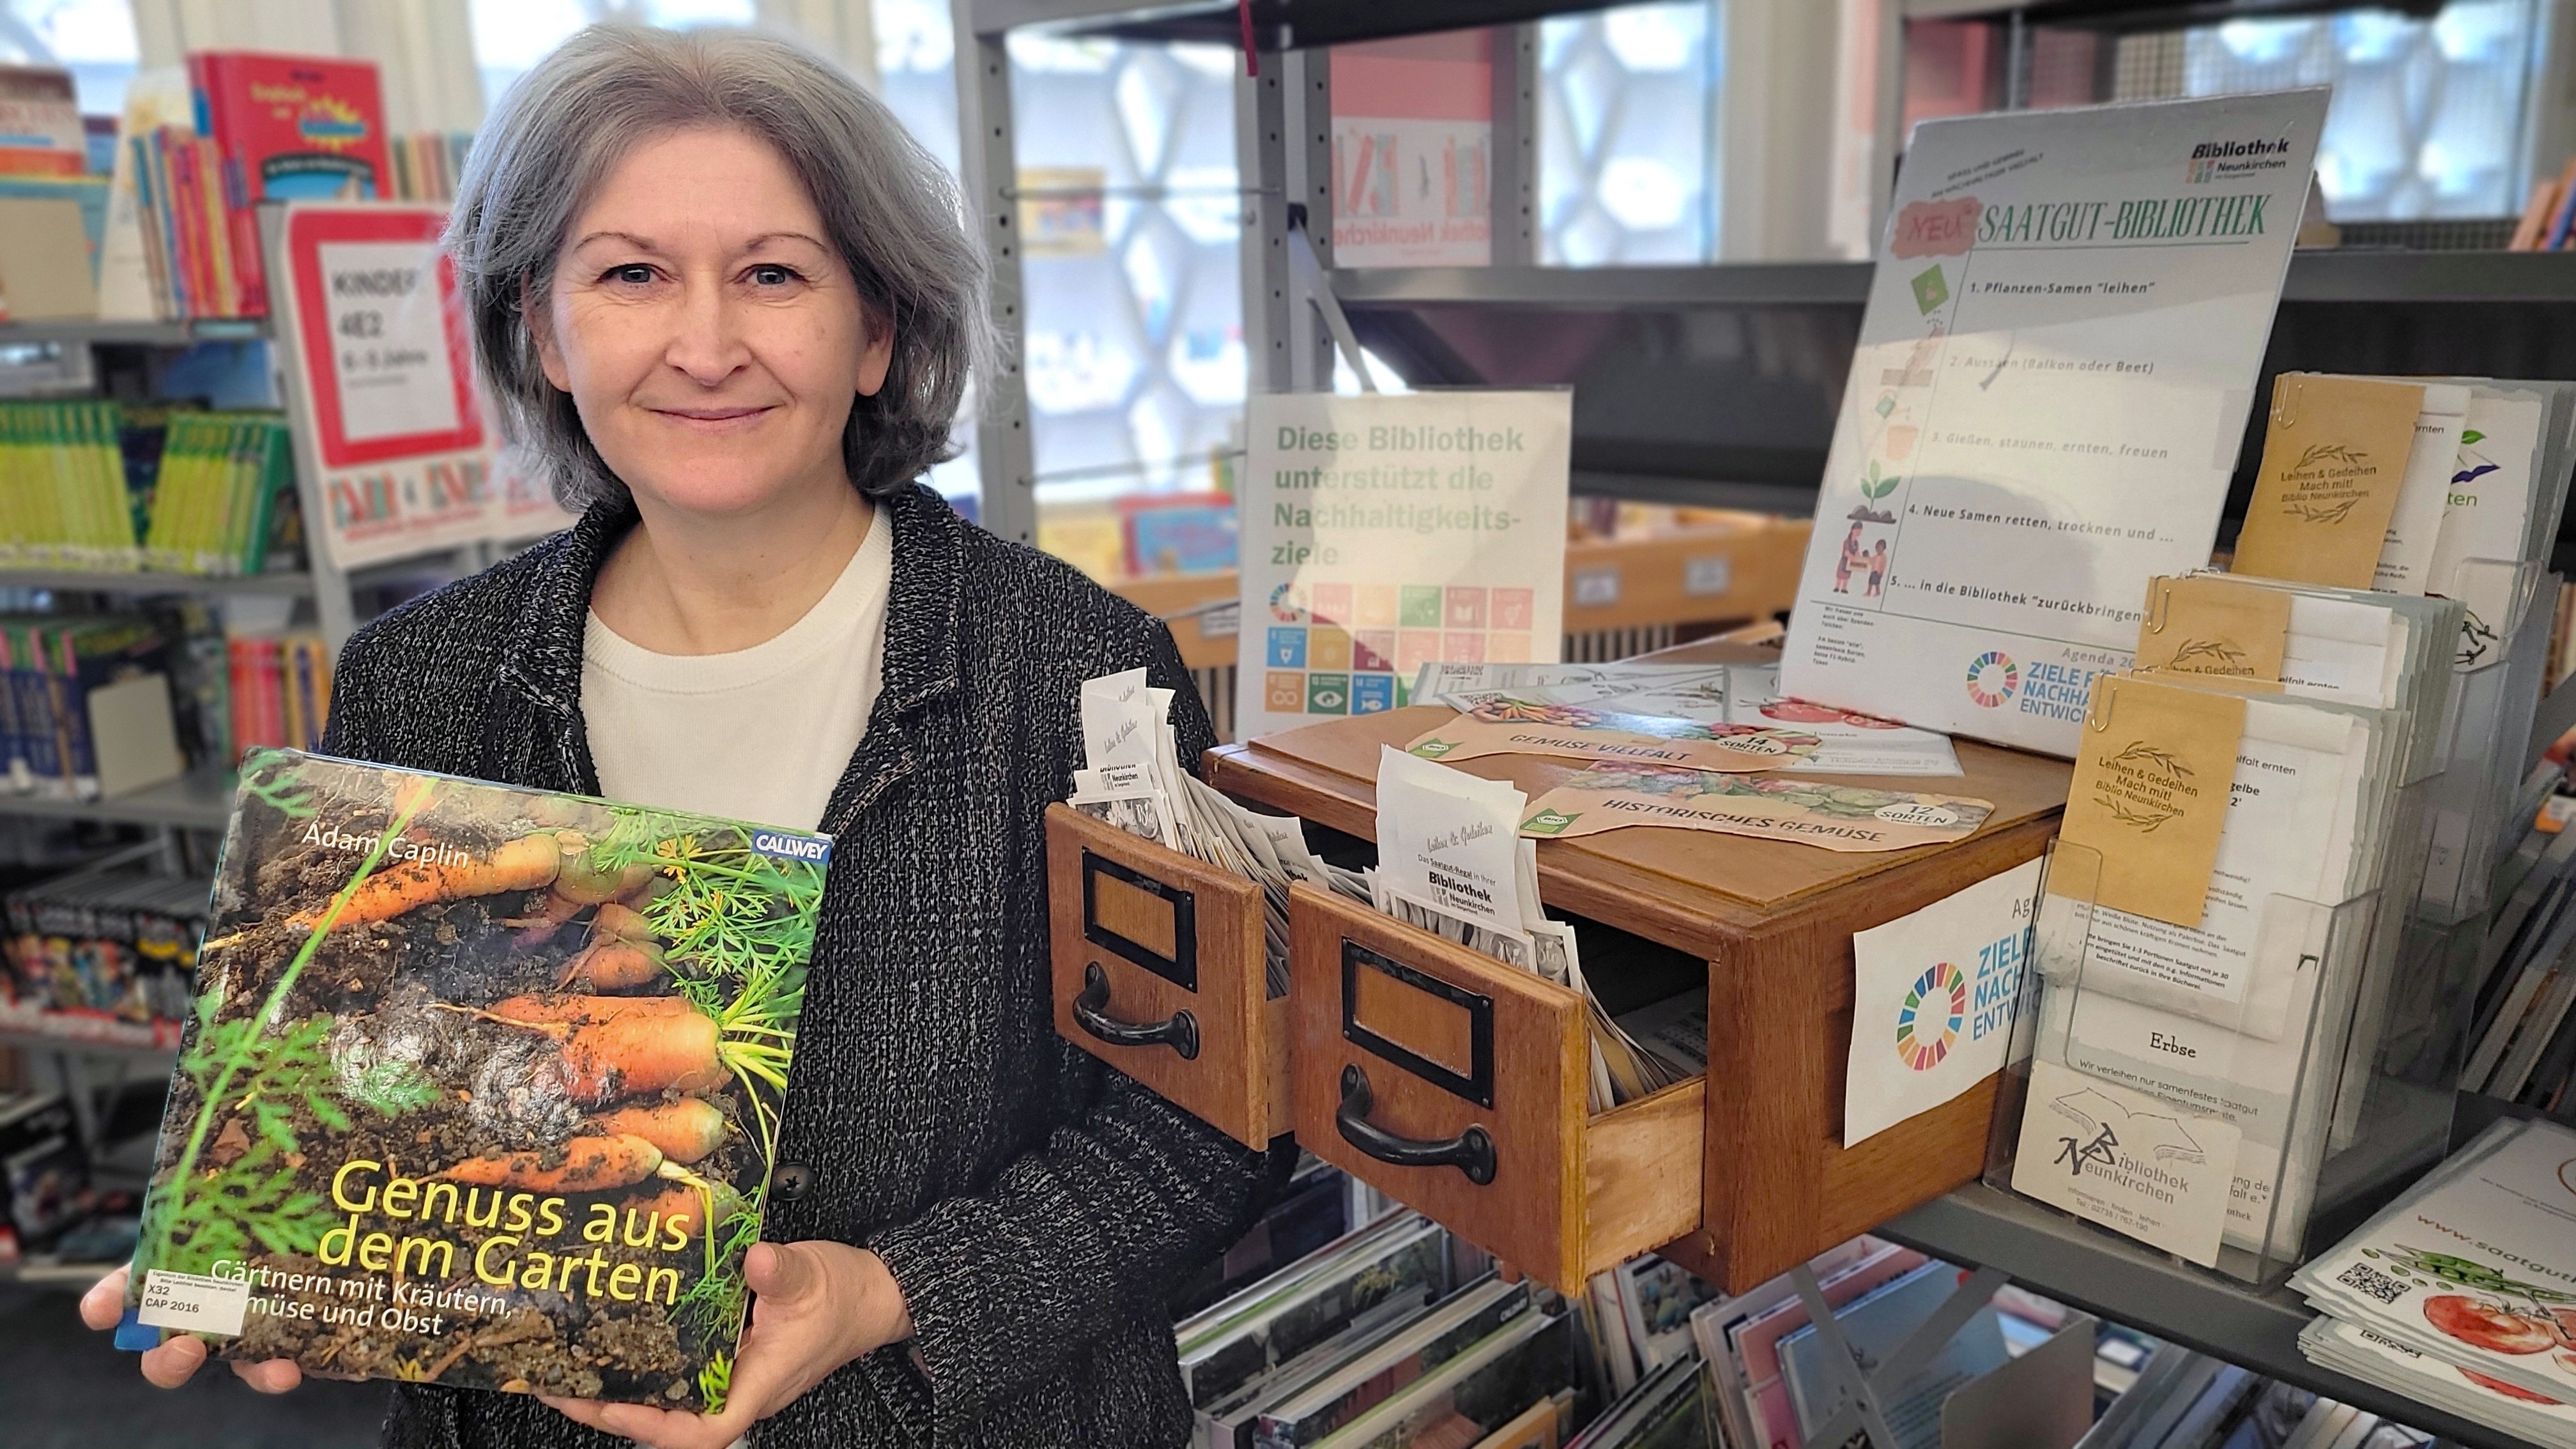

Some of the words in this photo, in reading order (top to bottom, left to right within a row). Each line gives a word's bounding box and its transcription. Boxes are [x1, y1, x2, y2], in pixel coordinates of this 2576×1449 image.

[2192, 137, 2290, 159] Bibliothek
[2217, 160, 2287, 172] Neunkirchen
[1978, 194, 2273, 242] SAATGUT-BIBLIOTHEK
[1970, 282, 1979, 293] 1.
[1984, 282, 2092, 294] Pflanzen-Samen
[2079, 361, 2111, 372] oder
[2115, 361, 2155, 374] Beet)
[1277, 426, 1358, 452] Diese
[1368, 425, 1524, 452] Bibliothek
[2119, 443, 2168, 459] freuen
[1275, 464, 1439, 491] unterstützt
[1448, 465, 1494, 491] die
[2281, 470, 2315, 482] Leihen
[2319, 470, 2325, 479] &
[2328, 466, 2377, 478] Gedeihen
[2300, 481, 2329, 491] Mach
[2310, 489, 2370, 501] Neunkirchen
[1273, 503, 1521, 533] Nachhaltigkeits-
[1908, 503, 1919, 515] 4.
[1924, 505, 1956, 519] Neue
[1959, 509, 2002, 524] Samen
[2005, 516, 2051, 531] retten,
[2057, 521, 2121, 537] trocknen
[2127, 528, 2156, 540] und
[1271, 540, 1338, 566] ziele
[1890, 576, 1901, 586] 5.
[1920, 579, 1931, 591] in
[1936, 581, 1955, 595] die
[1960, 585, 2027, 605] Bibliothek
[2062, 647, 2115, 666] Agenda
[2027, 661, 2080, 686] ZIELE
[1598, 744, 1692, 761] VIELFALT
[1720, 740, 1777, 754] SORTEN
[1746, 737, 1768, 745] 14
[1112, 772, 1138, 783] Neunkirchen
[2099, 756, 2135, 777] Leihen
[2136, 769, 2145, 779] &
[2147, 772, 2198, 797] Gedeihen
[2262, 760, 2296, 776] ernten
[2096, 780, 2122, 795] Biblio
[2124, 790, 2185, 817] Neunkirchen
[2116, 775, 2147, 793] Mach
[2149, 787, 2172, 801] mit!
[1602, 799, 1775, 829] HISTORISCHES
[1779, 820, 1889, 843] GEMÜSE
[1880, 811, 1948, 824] SORTEN
[1909, 806, 1935, 815] 12
[302, 823, 379, 855] Adam
[388, 837, 469, 870] Caplin
[756, 834, 828, 860] CALLWEY
[1418, 854, 1429, 864] Das
[1430, 858, 1473, 880] Saatgut-Regal
[1474, 872, 1480, 880] in
[1481, 875, 1496, 887] Ihrer
[1429, 871, 1492, 903] Bibliothek
[1450, 893, 1496, 916] Neunkirchen
[2097, 935, 2120, 947] bringen
[2143, 949, 2174, 963] Portionen
[2175, 958, 2199, 971] Saatgut
[2096, 945, 2127, 958] eingetütet
[2128, 954, 2140, 962] und
[2152, 962, 2165, 970] den
[2179, 970, 2225, 988] Informationen
[2096, 953, 2129, 968] beschriftet
[2129, 963, 2149, 974] zurück
[2158, 971, 2171, 981] Ihre
[2172, 977, 2202, 990] Bücherei.
[2150, 1032, 2196, 1058] Erbse
[2080, 1059, 2095, 1070] Wir
[2097, 1064, 2138, 1082] verleihen
[2140, 1077, 2156, 1087] nur
[2158, 1081, 2218, 1104] samenfestes
[331, 1159, 565, 1237] Genuss
[582, 1201, 691, 1253] aus
[318, 1214, 454, 1279] dem
[474, 1234, 680, 1307] Garten
[148, 1284, 170, 1296] X32
[210, 1259, 332, 1295] Gärtnern
[339, 1276, 386, 1301] mit
[392, 1281, 512, 1319] Kräutern,
[146, 1298, 168, 1309] CAP
[169, 1301, 200, 1314] 2016
[245, 1293, 314, 1321] müse
[322, 1303, 374, 1328] und
[381, 1307, 443, 1336] Obst
